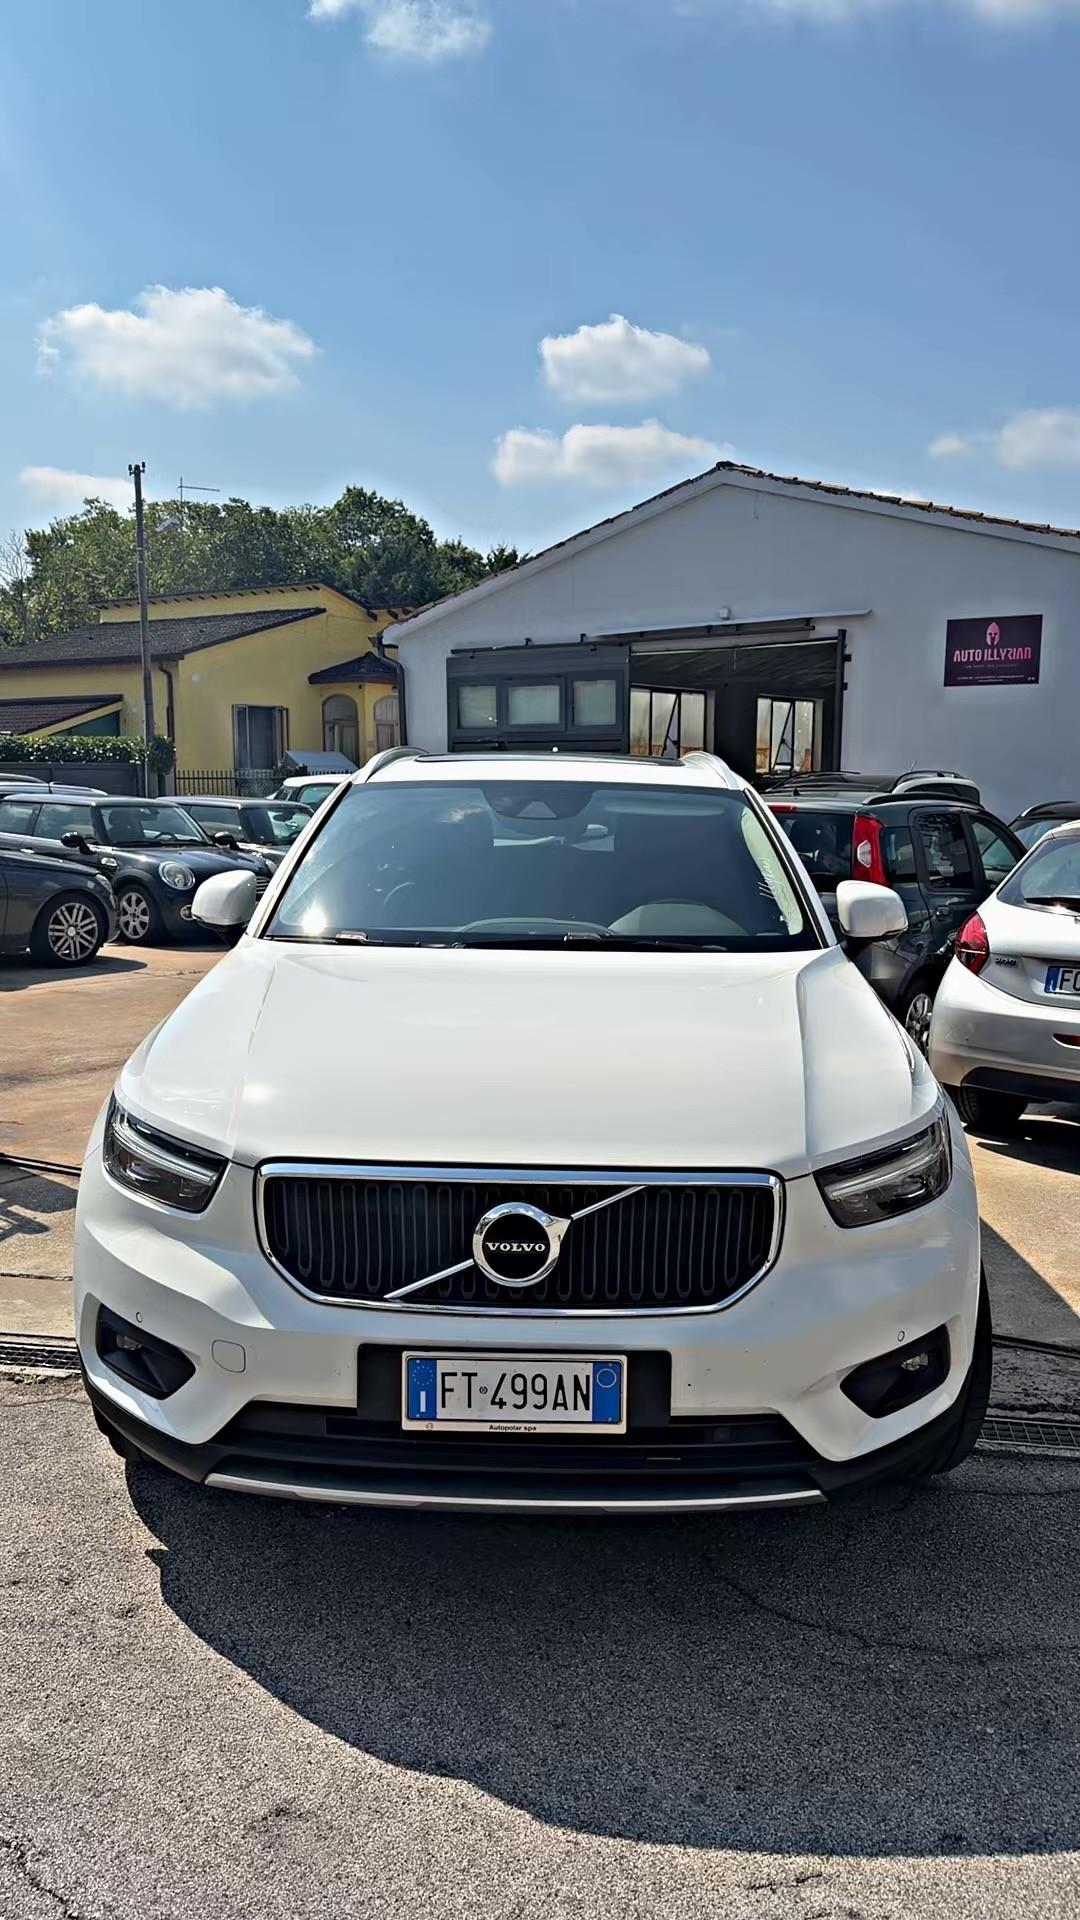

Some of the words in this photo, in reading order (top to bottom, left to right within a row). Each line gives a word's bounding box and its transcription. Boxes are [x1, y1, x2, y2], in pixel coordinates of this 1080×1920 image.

[953, 649, 982, 662] AUTO
[984, 647, 1032, 661] ILLYRIAN
[485, 1242, 546, 1252] VOLVO
[440, 1372, 478, 1409] FT
[490, 1373, 591, 1411] 499AN
